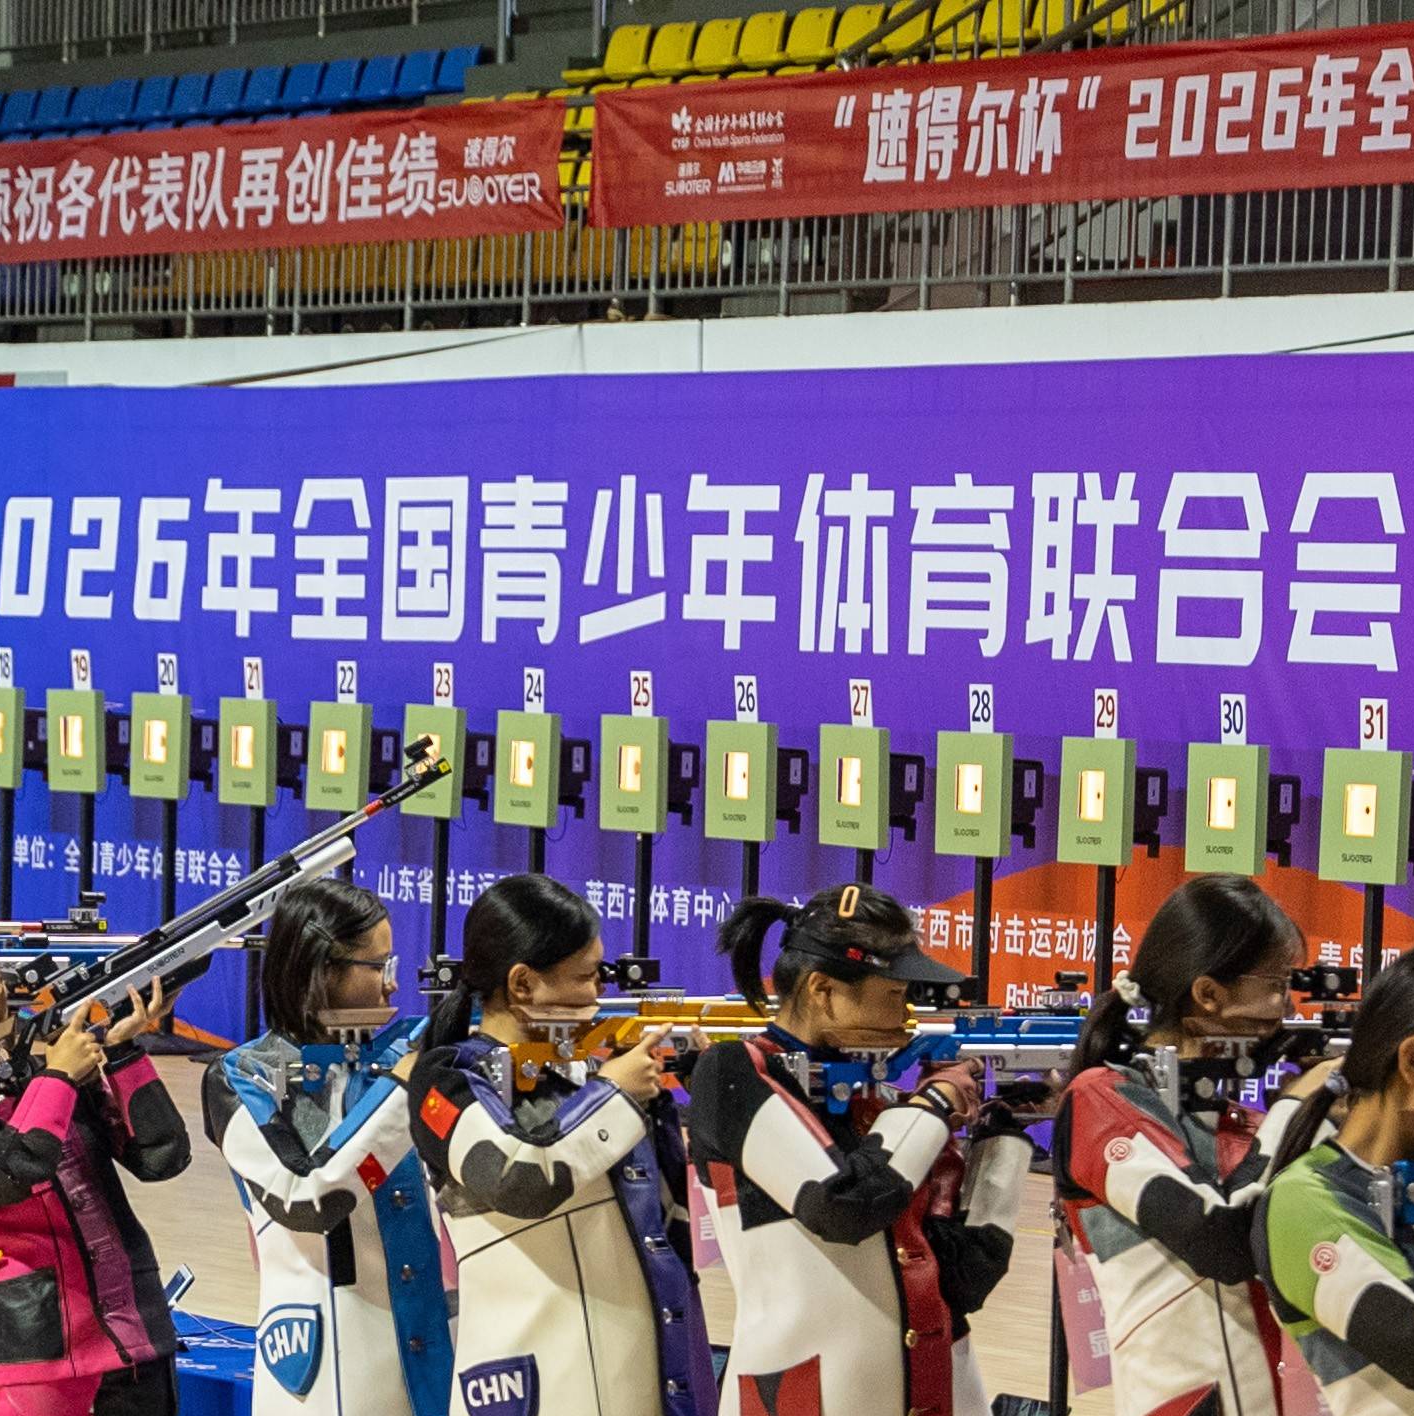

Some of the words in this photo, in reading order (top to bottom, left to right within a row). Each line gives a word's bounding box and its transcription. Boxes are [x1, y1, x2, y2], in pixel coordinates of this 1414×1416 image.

[464, 136, 515, 170] 速得尔
[74, 656, 87, 681] 19
[159, 659, 174, 686] 20
[248, 663, 259, 690] 21
[339, 666, 354, 694] 22
[436, 668, 450, 697] 23
[527, 673, 544, 703] 24
[633, 677, 649, 707] 25
[737, 681, 755, 712] 26
[852, 685, 868, 716] 27
[972, 690, 991, 722] 28
[1097, 695, 1115, 728] 29
[1223, 700, 1243, 734] 30
[1364, 705, 1383, 739] 31
[263, 1319, 311, 1366] CHN
[466, 1370, 524, 1408] CHN
